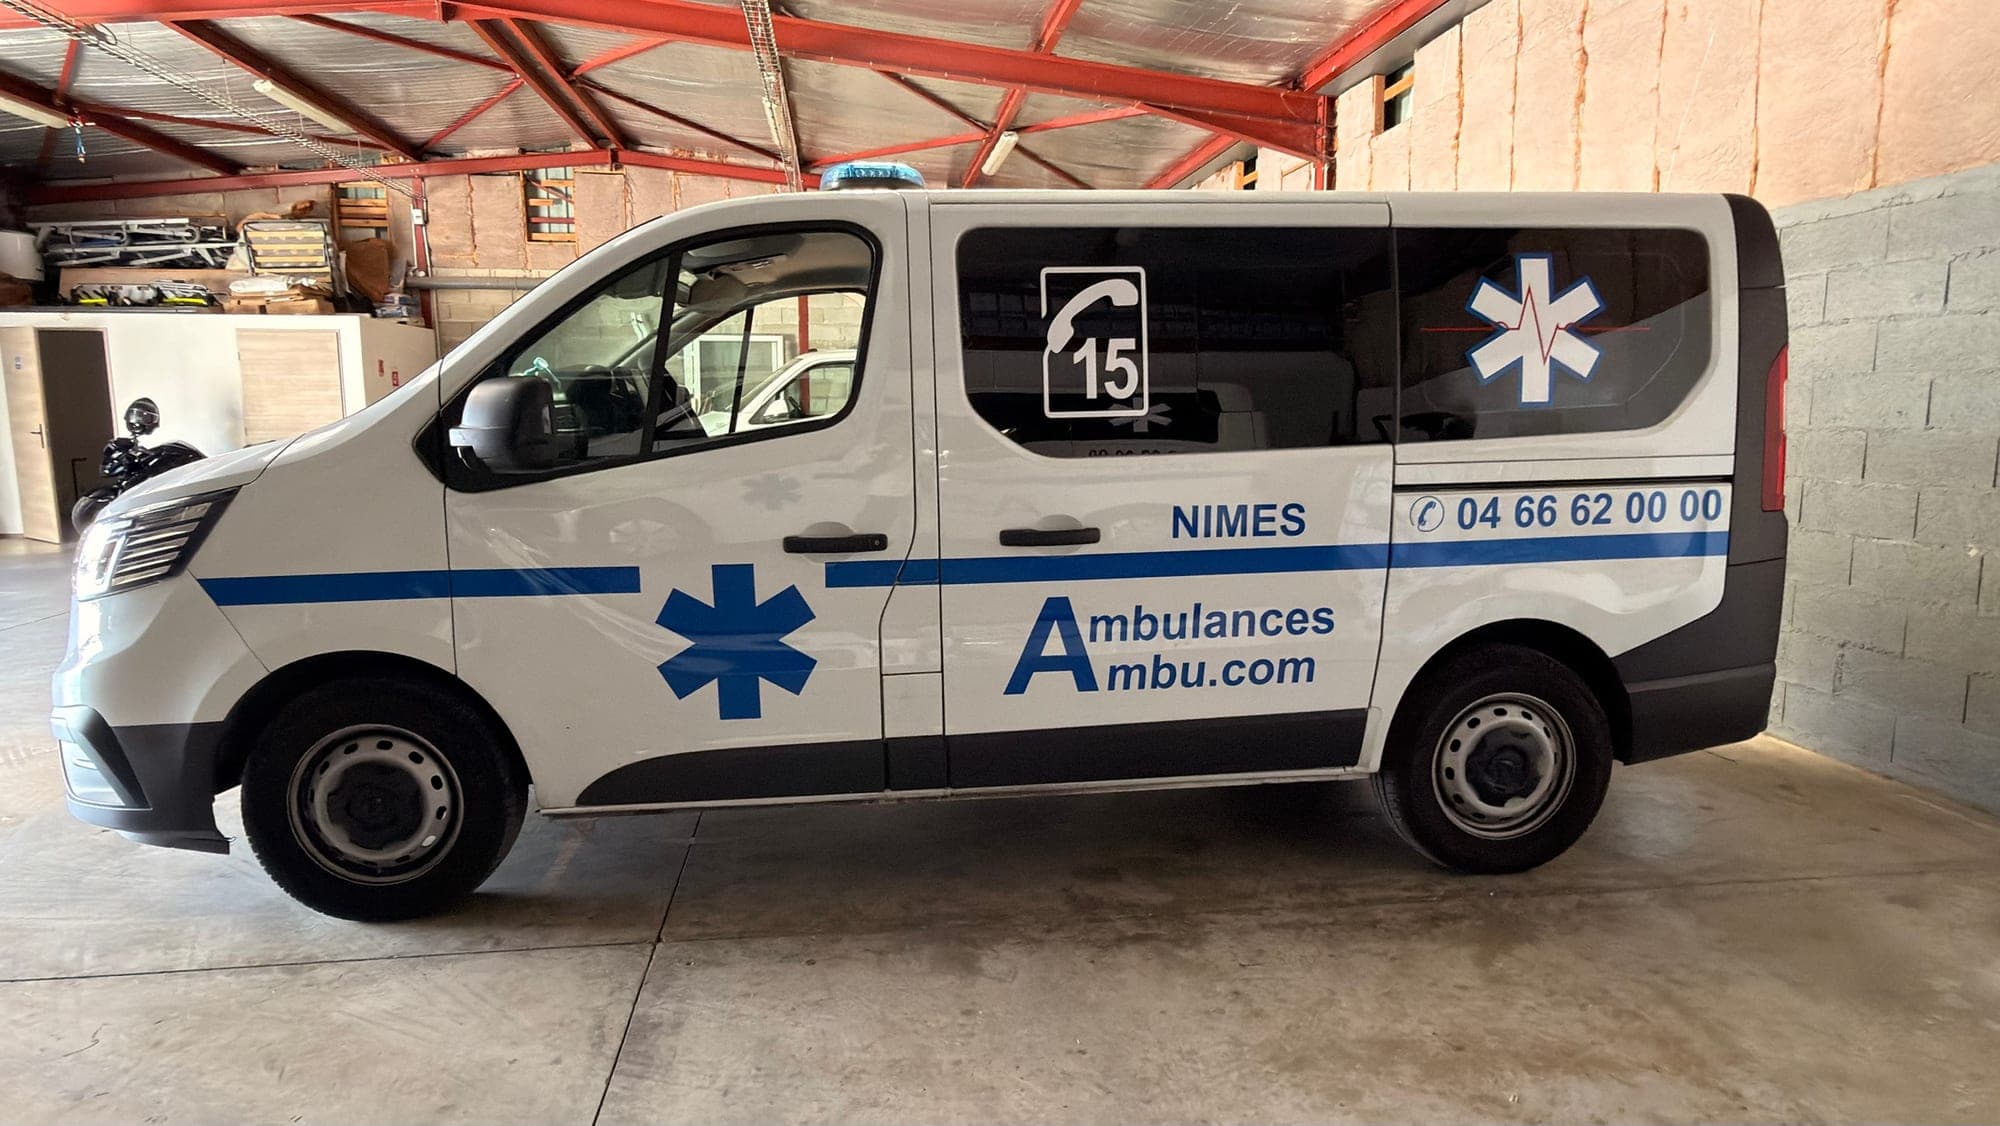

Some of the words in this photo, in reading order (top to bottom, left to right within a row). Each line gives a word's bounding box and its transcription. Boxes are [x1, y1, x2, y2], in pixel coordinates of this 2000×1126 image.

[1073, 337, 1139, 399] 15
[1172, 503, 1306, 538] NIMES
[1457, 496, 1501, 529] 04
[1514, 495, 1558, 528] 66
[1570, 493, 1613, 526] 62
[1625, 491, 1667, 524] 00
[1680, 489, 1722, 521] 00
